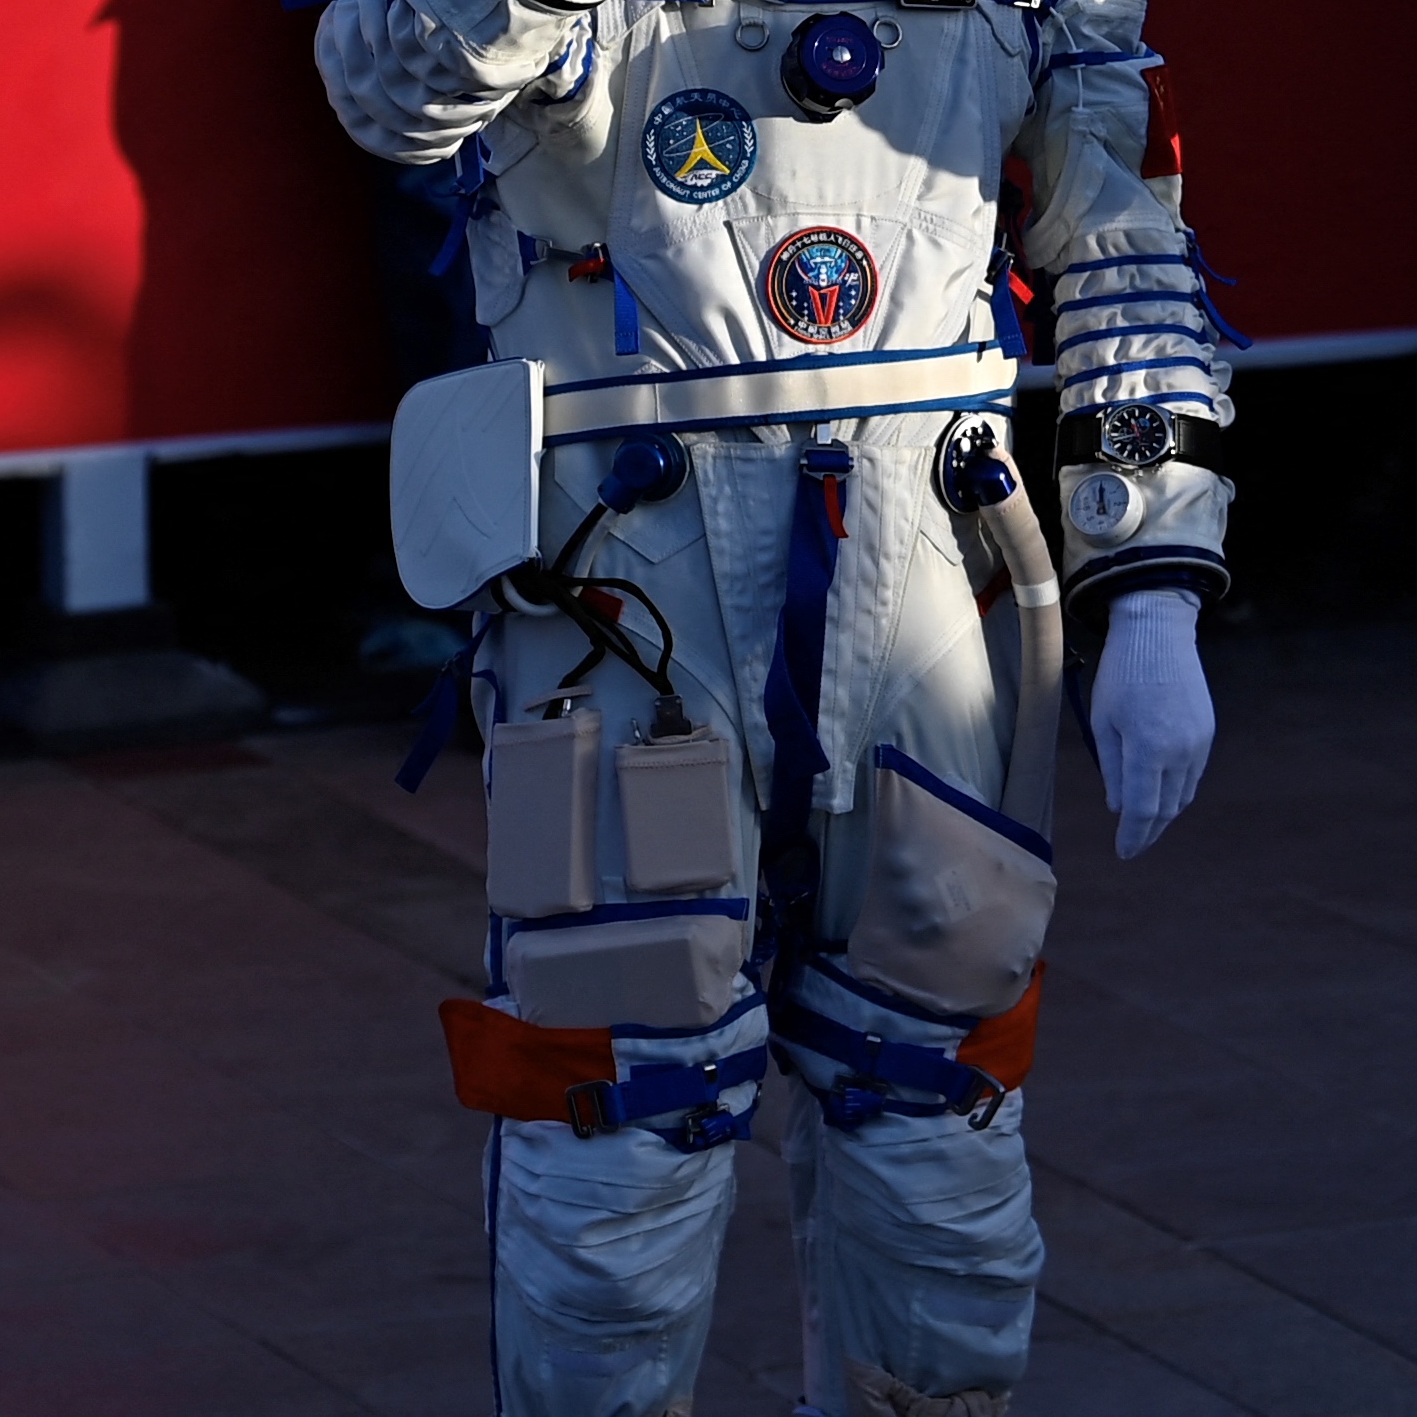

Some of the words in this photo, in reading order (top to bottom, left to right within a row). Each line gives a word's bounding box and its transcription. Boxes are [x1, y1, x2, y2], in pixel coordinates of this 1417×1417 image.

[653, 92, 742, 126] 中国航天员中心
[652, 167, 690, 198] ASTRONAUT
[692, 187, 720, 200] CENTER
[721, 181, 732, 191] OF
